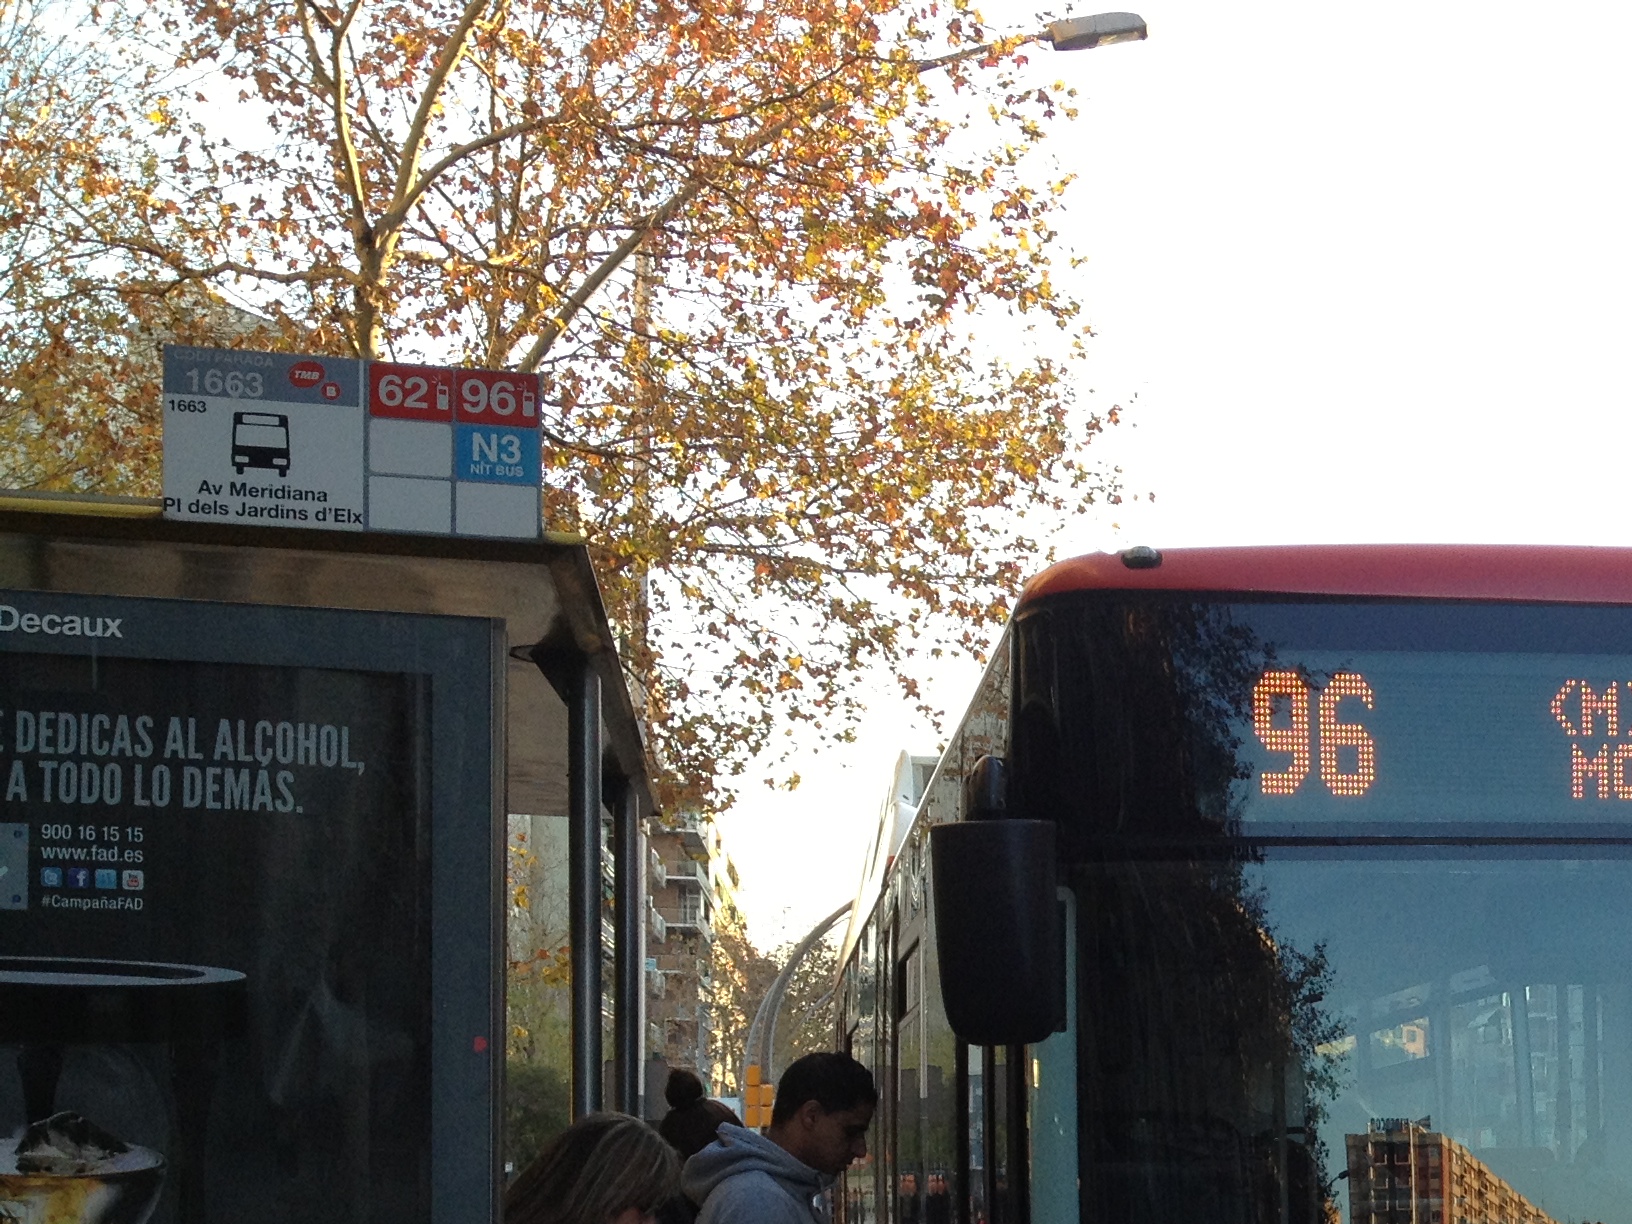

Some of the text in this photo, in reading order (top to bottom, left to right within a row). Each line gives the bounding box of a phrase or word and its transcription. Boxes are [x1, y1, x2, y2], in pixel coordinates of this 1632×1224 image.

[186, 367, 264, 398] 1663
[294, 370, 320, 381] TMB
[326, 385, 337, 397] B
[378, 374, 429, 409] 62
[461, 378, 517, 416] 96
[168, 399, 207, 413] 1663
[472, 432, 522, 464] N3
[496, 466, 525, 477] BUS
[198, 480, 328, 502] Av Meridiana
[163, 497, 181, 513] Pl
[188, 500, 229, 516] dels
[235, 502, 308, 521] Jardins
[15, 710, 154, 758] DEDICAS
[164, 717, 204, 760] AL
[214, 718, 365, 776] ALCOHOL,
[1253, 670, 1375, 796] 96
[6, 757, 304, 814] A TODO LO DEMÁS.
[41, 824, 144, 843] 900 16 15 15
[41, 844, 144, 862] www.fad.es
[41, 895, 144, 910] #CampañaFAD
